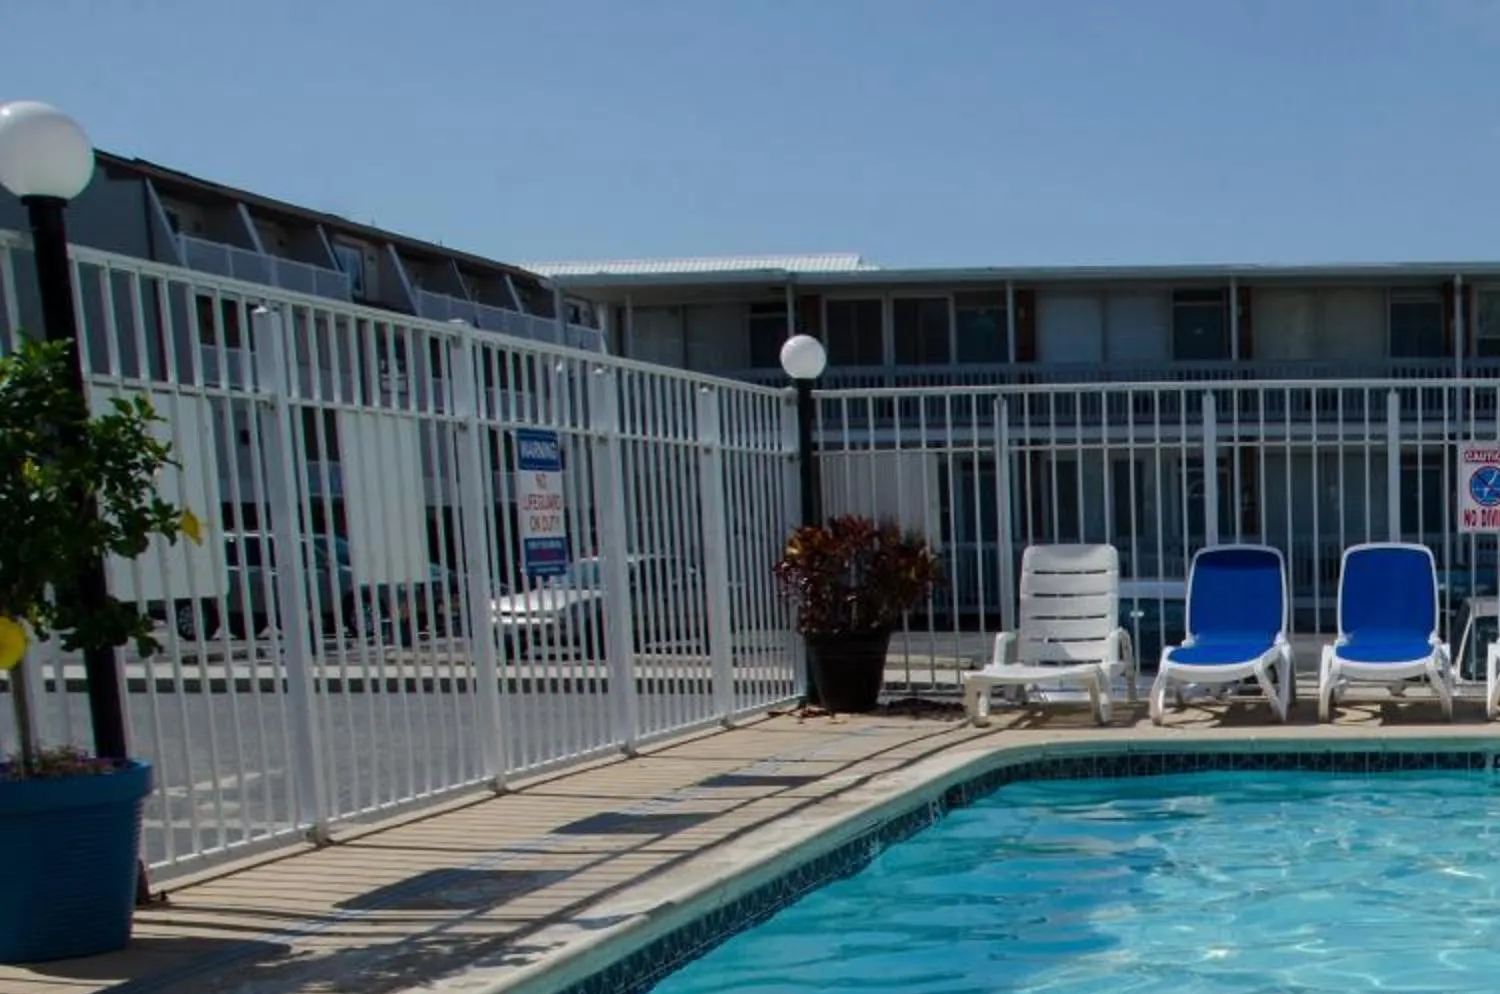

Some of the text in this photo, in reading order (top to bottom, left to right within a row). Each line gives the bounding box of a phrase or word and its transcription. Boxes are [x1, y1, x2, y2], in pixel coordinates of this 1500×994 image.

[535, 473, 547, 488] NO
[529, 515, 560, 532] ON DUTY
[1464, 508, 1477, 527] NO
